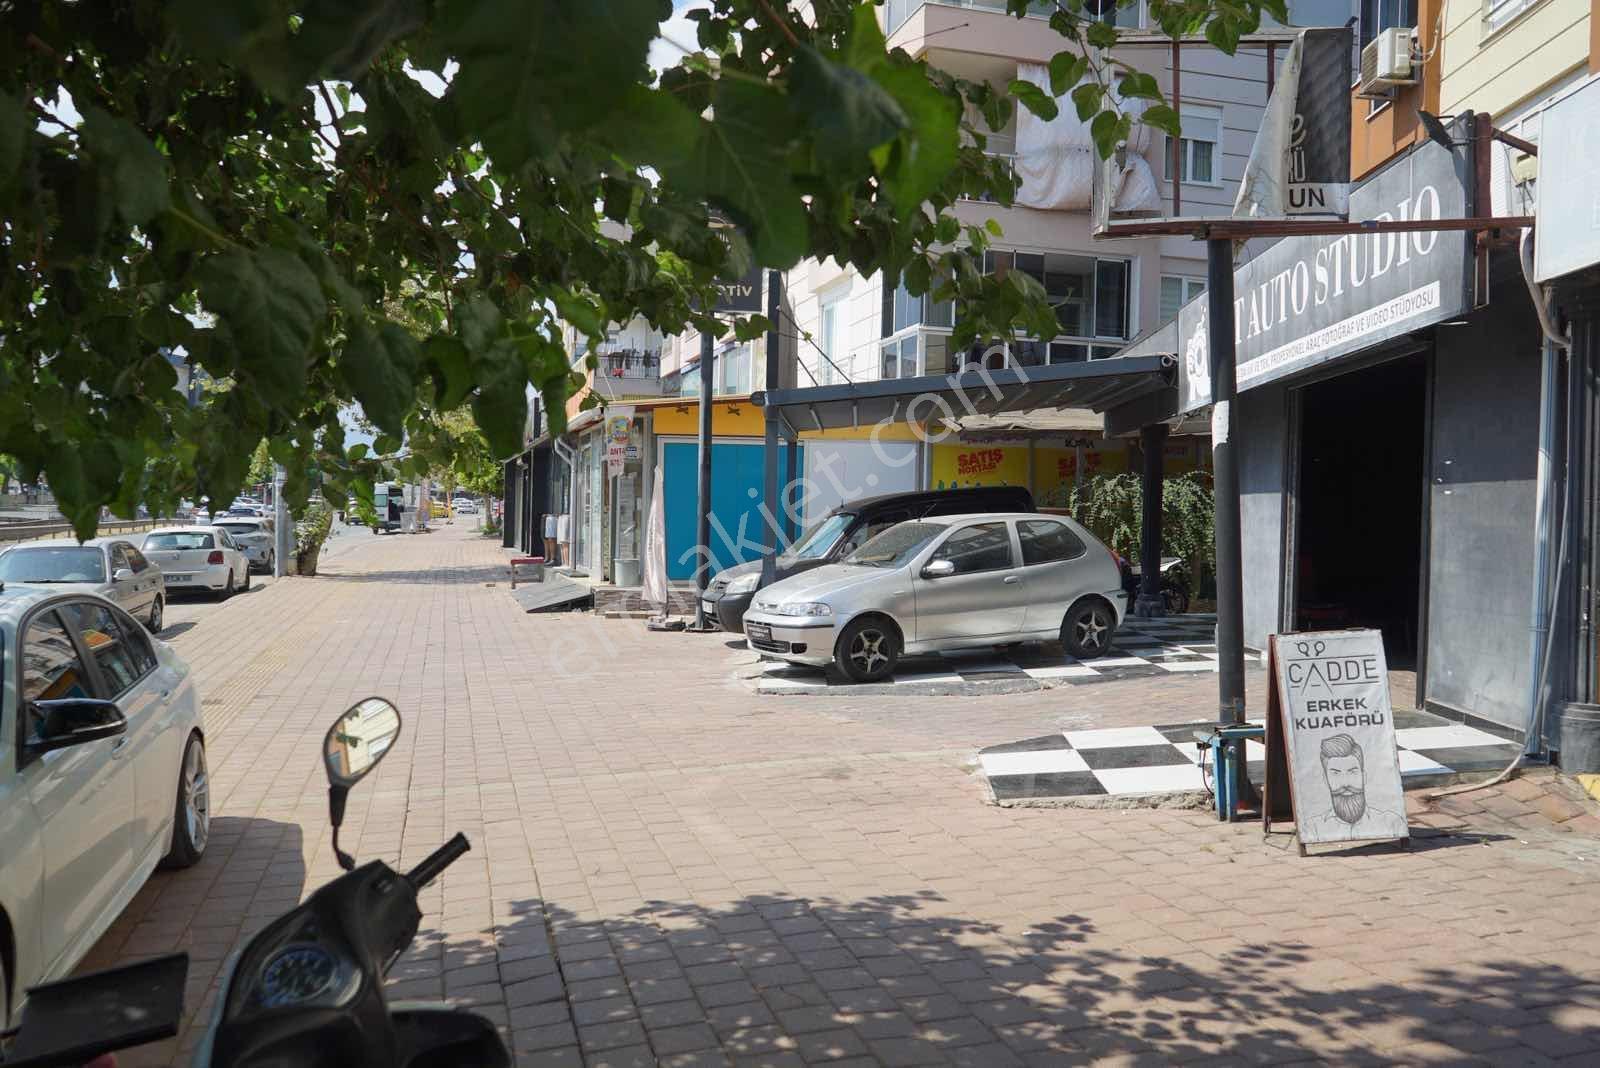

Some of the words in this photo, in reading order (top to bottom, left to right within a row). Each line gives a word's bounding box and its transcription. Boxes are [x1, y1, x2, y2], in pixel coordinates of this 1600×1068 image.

[1247, 260, 1309, 339] AUTO
[1314, 185, 1441, 307] STUDIO
[1390, 287, 1434, 319] STÜDYOSU
[1288, 658, 1380, 696] CADDE
[1295, 709, 1385, 730] KUAFÖRÜ
[1306, 696, 1368, 713] ERKEK
